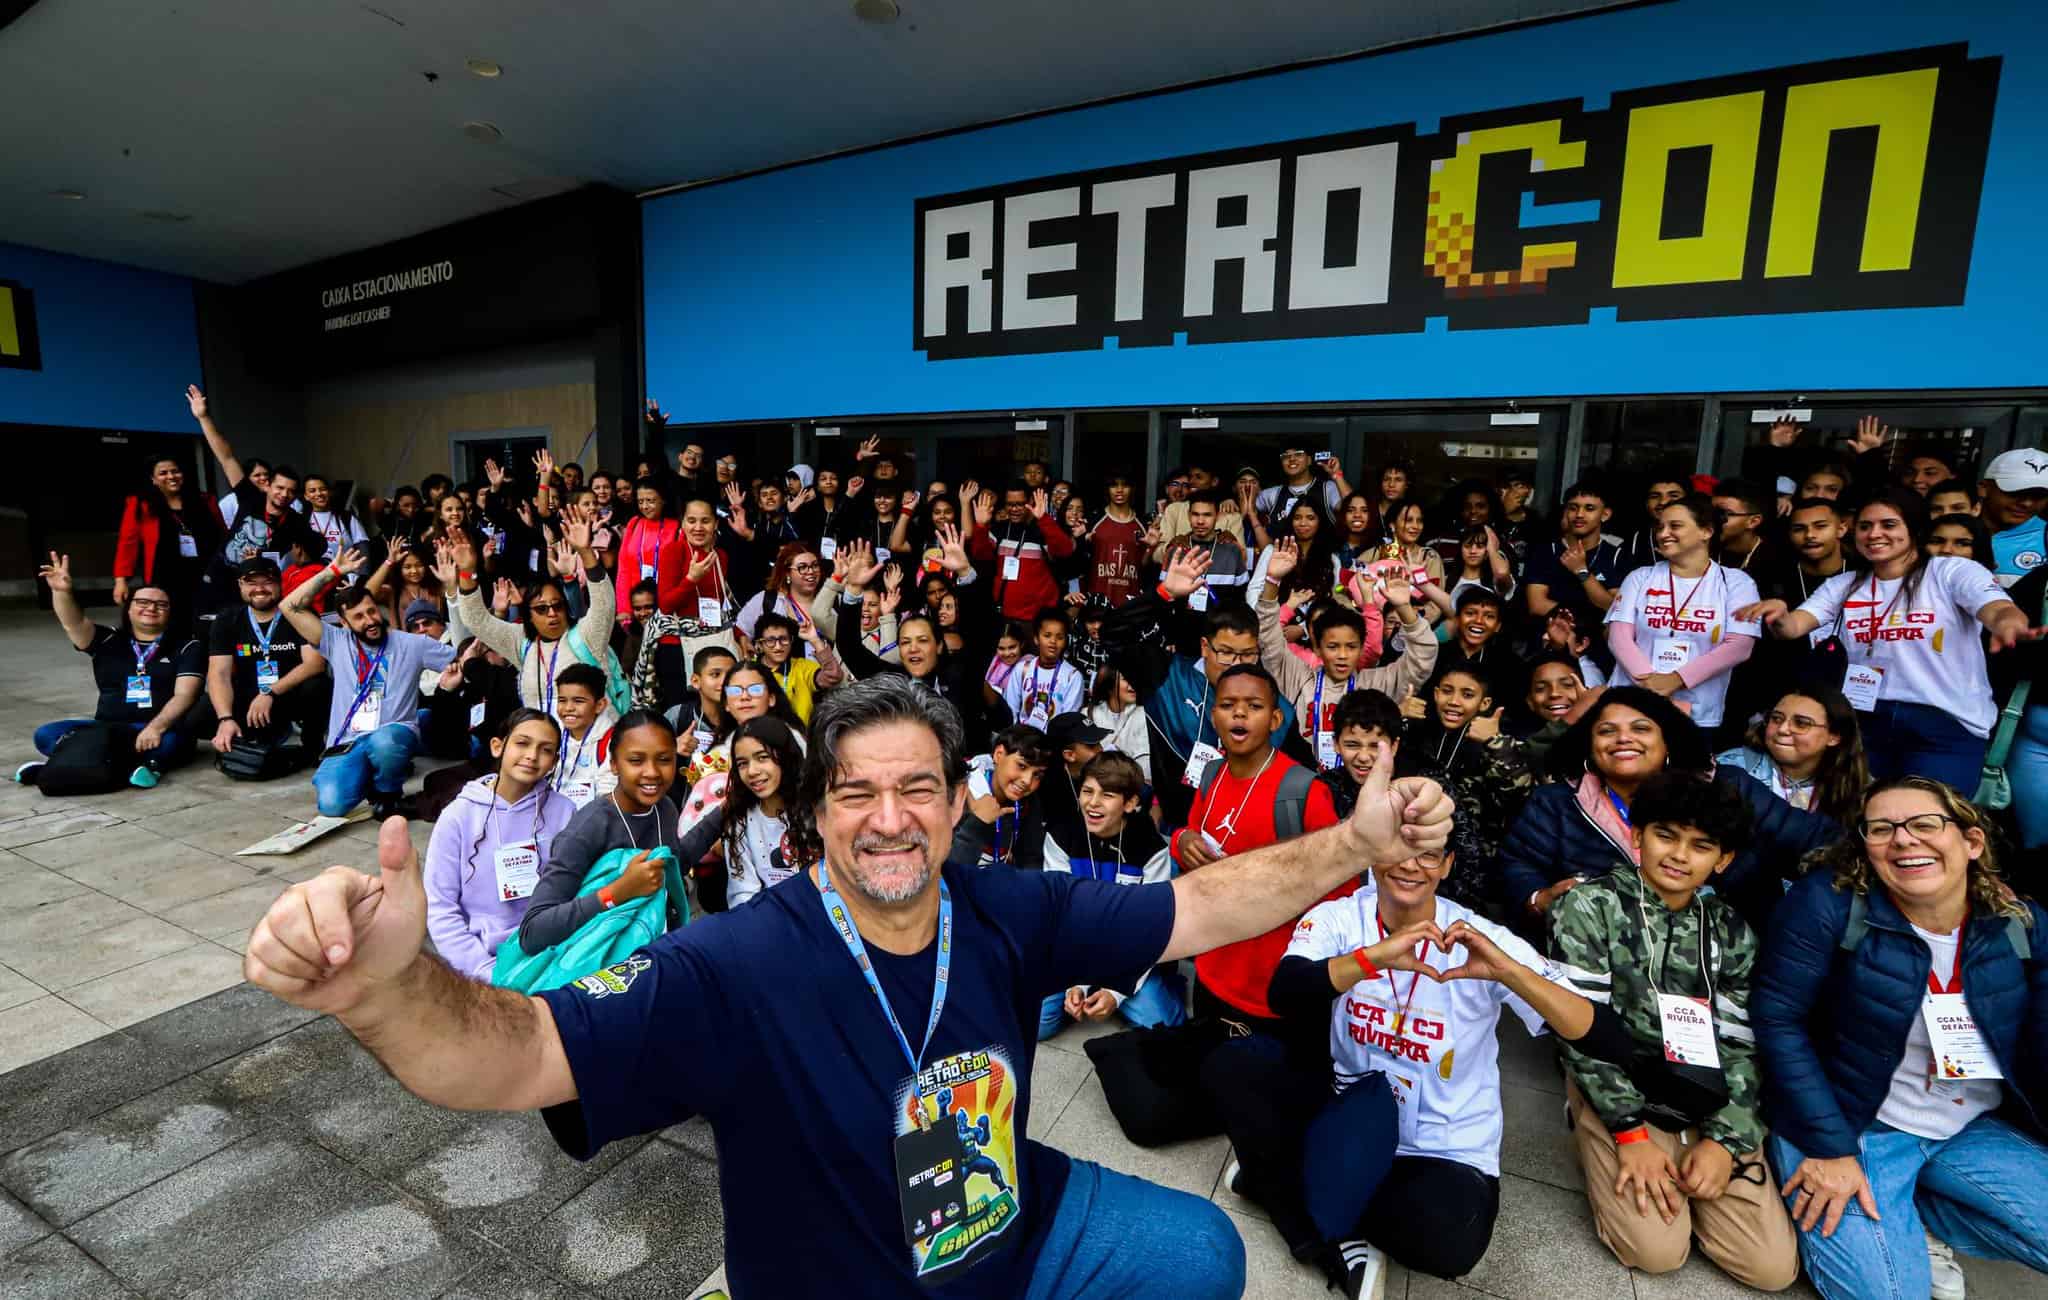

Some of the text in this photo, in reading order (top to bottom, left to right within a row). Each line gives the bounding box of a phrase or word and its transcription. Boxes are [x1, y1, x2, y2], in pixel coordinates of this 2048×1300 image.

[923, 66, 1939, 339] RETROCON
[322, 260, 453, 308] CAIXA ESTACIONAMENTO
[252, 641, 297, 653] Mosoft
[1854, 627, 1924, 644] RIIERA
[1345, 997, 1387, 1025] CCA
[1412, 1017, 1445, 1041] CJ
[1666, 1013, 1706, 1025] RIVIERA
[1673, 1006, 1696, 1016] CCA
[1347, 1021, 1431, 1063] RIVIERA
[908, 1159, 953, 1188] RETROCON
